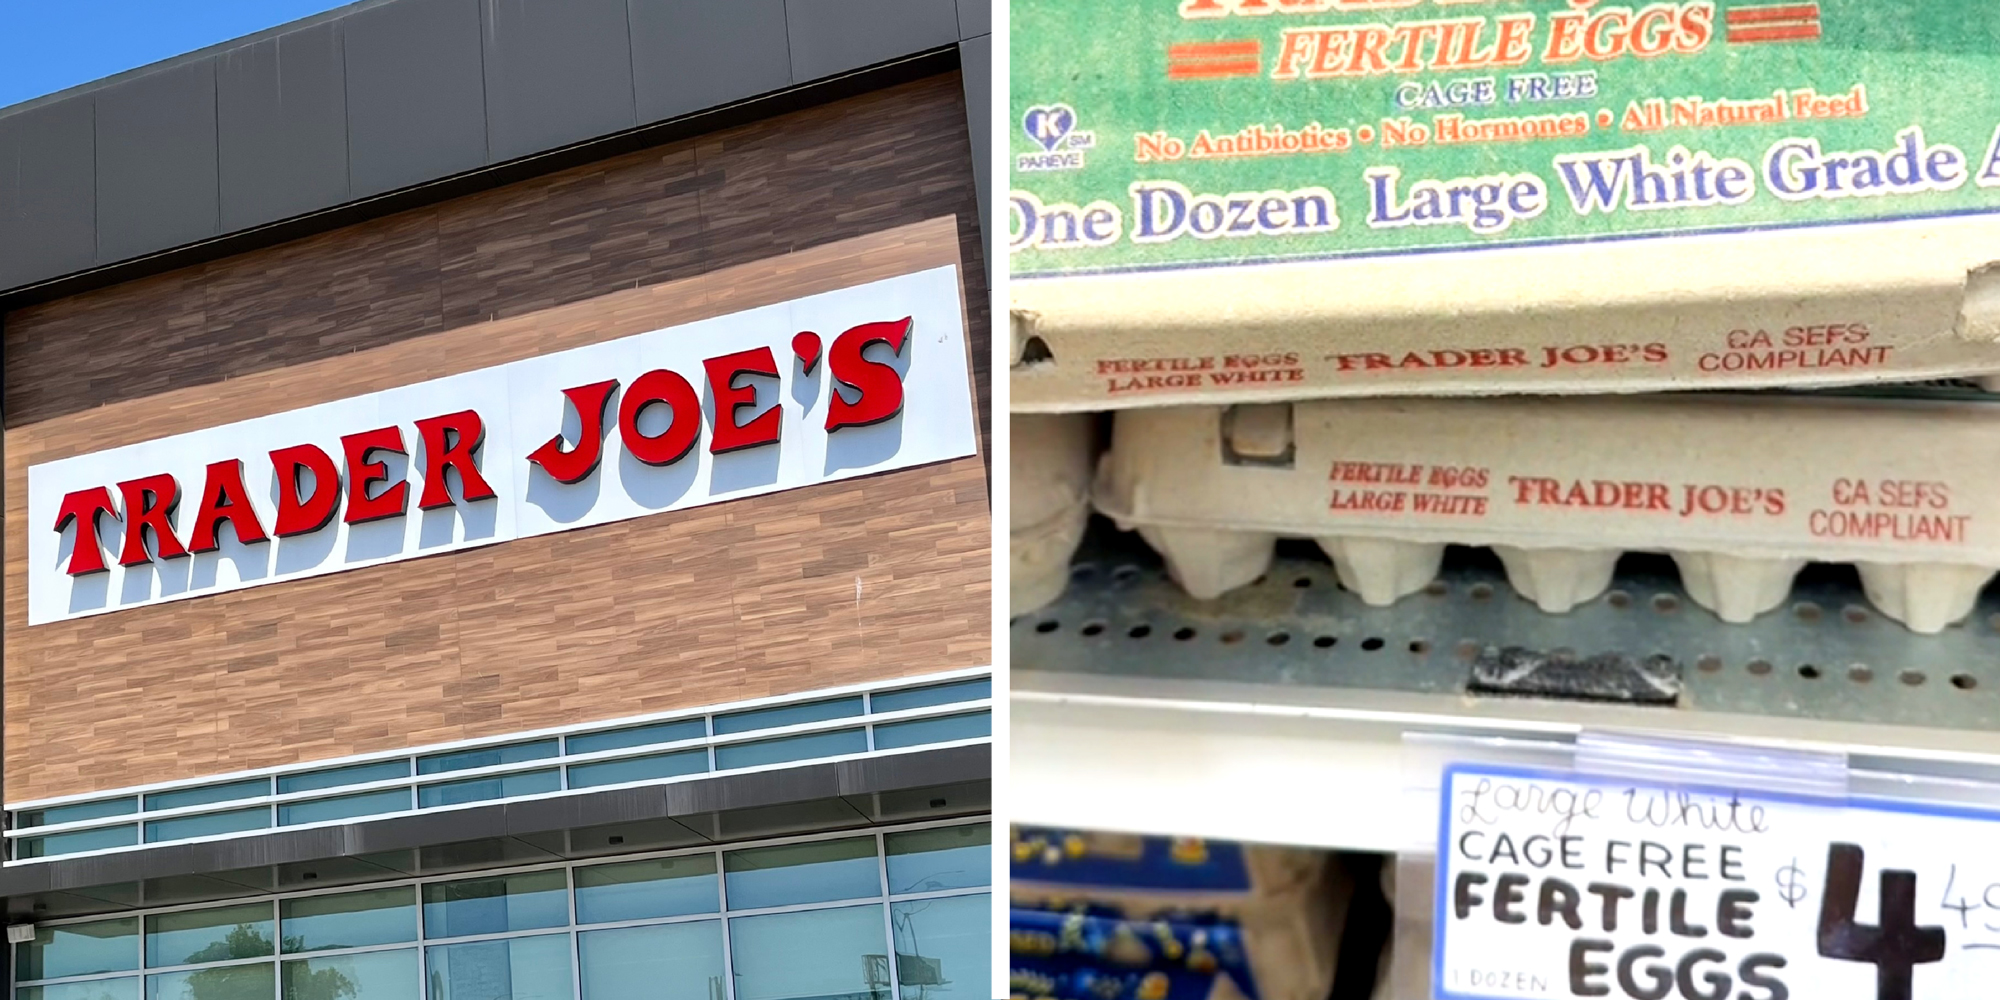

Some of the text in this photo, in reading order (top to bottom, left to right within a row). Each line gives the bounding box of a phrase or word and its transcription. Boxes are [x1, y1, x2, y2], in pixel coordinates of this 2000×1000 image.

[1276, 4, 1712, 77] FERTILE EGGS
[1396, 74, 1597, 108] CAGE FREE
[1138, 90, 1862, 159] No Antibiotics No Hormones All Natural Feed
[1019, 153, 1080, 169] PAREVE
[1137, 187, 1330, 237] Dozen
[1370, 174, 1540, 229] Large
[1558, 153, 1746, 208] White
[1769, 132, 1958, 193] Grade
[1727, 323, 1869, 348] CA SEFS
[1097, 353, 1299, 374] FERTILE EGGS
[1326, 342, 1668, 371] TRADER JOE'S
[1700, 345, 1894, 371] COMPLIANT
[1108, 369, 1304, 391] LARGE WHITE
[54, 315, 913, 576] TRADER JOE'S
[1330, 461, 1490, 489] FERTILE EGGS
[1330, 489, 1487, 515] LARGE WHITE
[1509, 477, 1786, 516] TRADER JOE'S
[1833, 478, 1949, 508] CA SEFS
[1809, 510, 1972, 542] COMPLIANT
[1460, 778, 1770, 837] Large White
[1459, 831, 1746, 880] CAGE FREE
[1455, 872, 1760, 938] FERTILE
[1817, 841, 1946, 1000] 4
[1470, 968, 1547, 992] DOZEN
[1569, 939, 1789, 1000] EGGS
